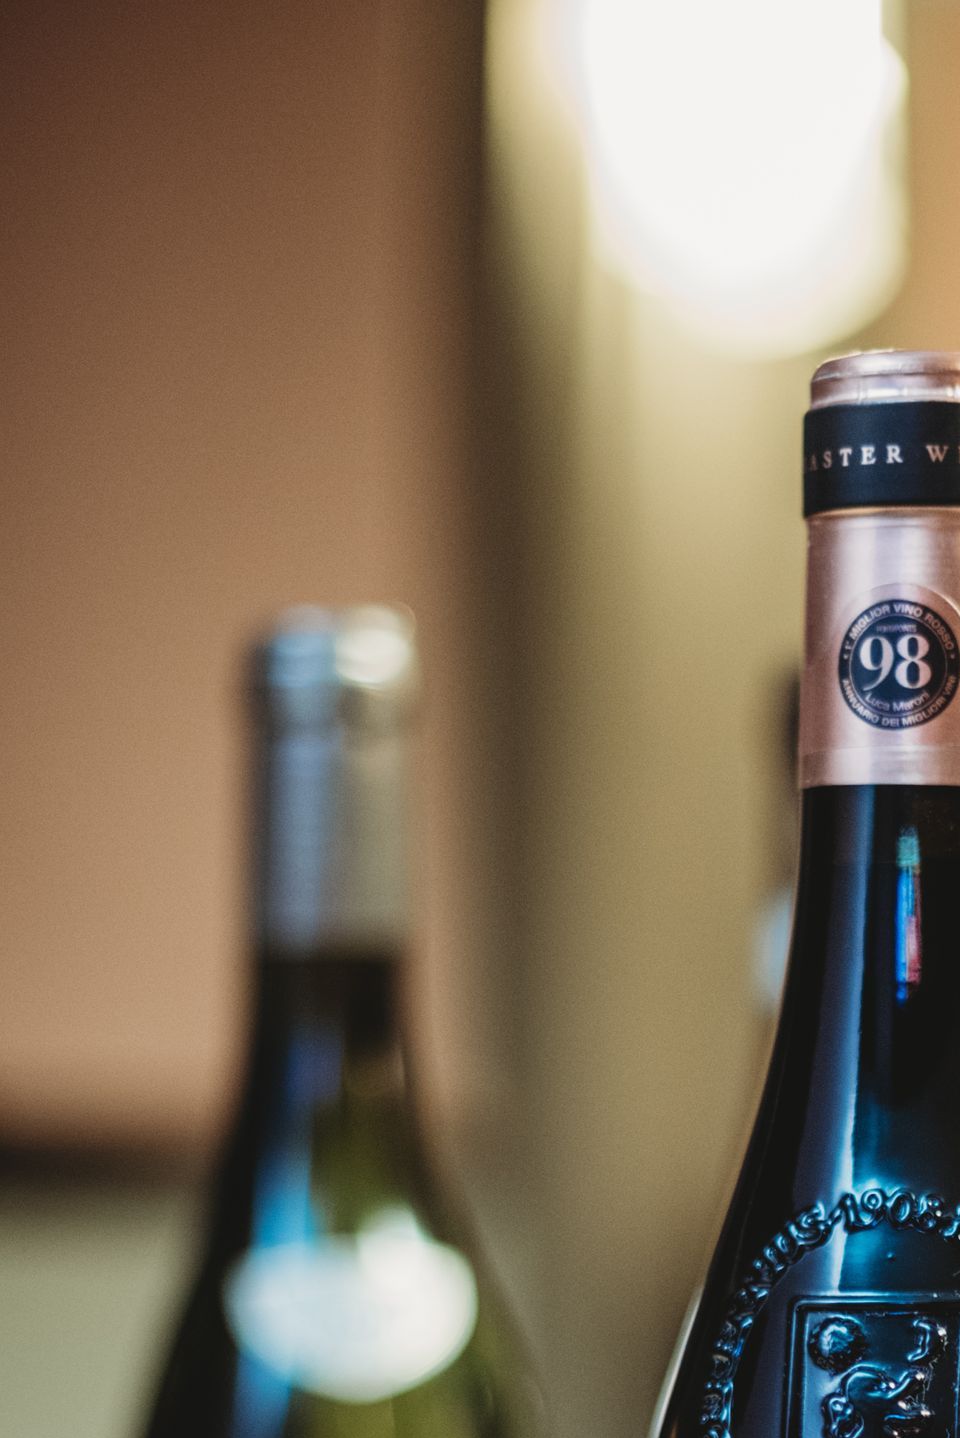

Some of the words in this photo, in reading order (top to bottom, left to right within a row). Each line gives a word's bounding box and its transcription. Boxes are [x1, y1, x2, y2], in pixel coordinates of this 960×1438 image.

[808, 444, 903, 471] ASTER
[849, 605, 891, 639] MIGLIOR
[893, 602, 923, 617] VINO
[924, 613, 955, 650] ROSSO
[860, 634, 931, 691] 98
[865, 692, 890, 711] Luca
[892, 690, 930, 711] Maroni
[881, 717, 900, 727] DEI
